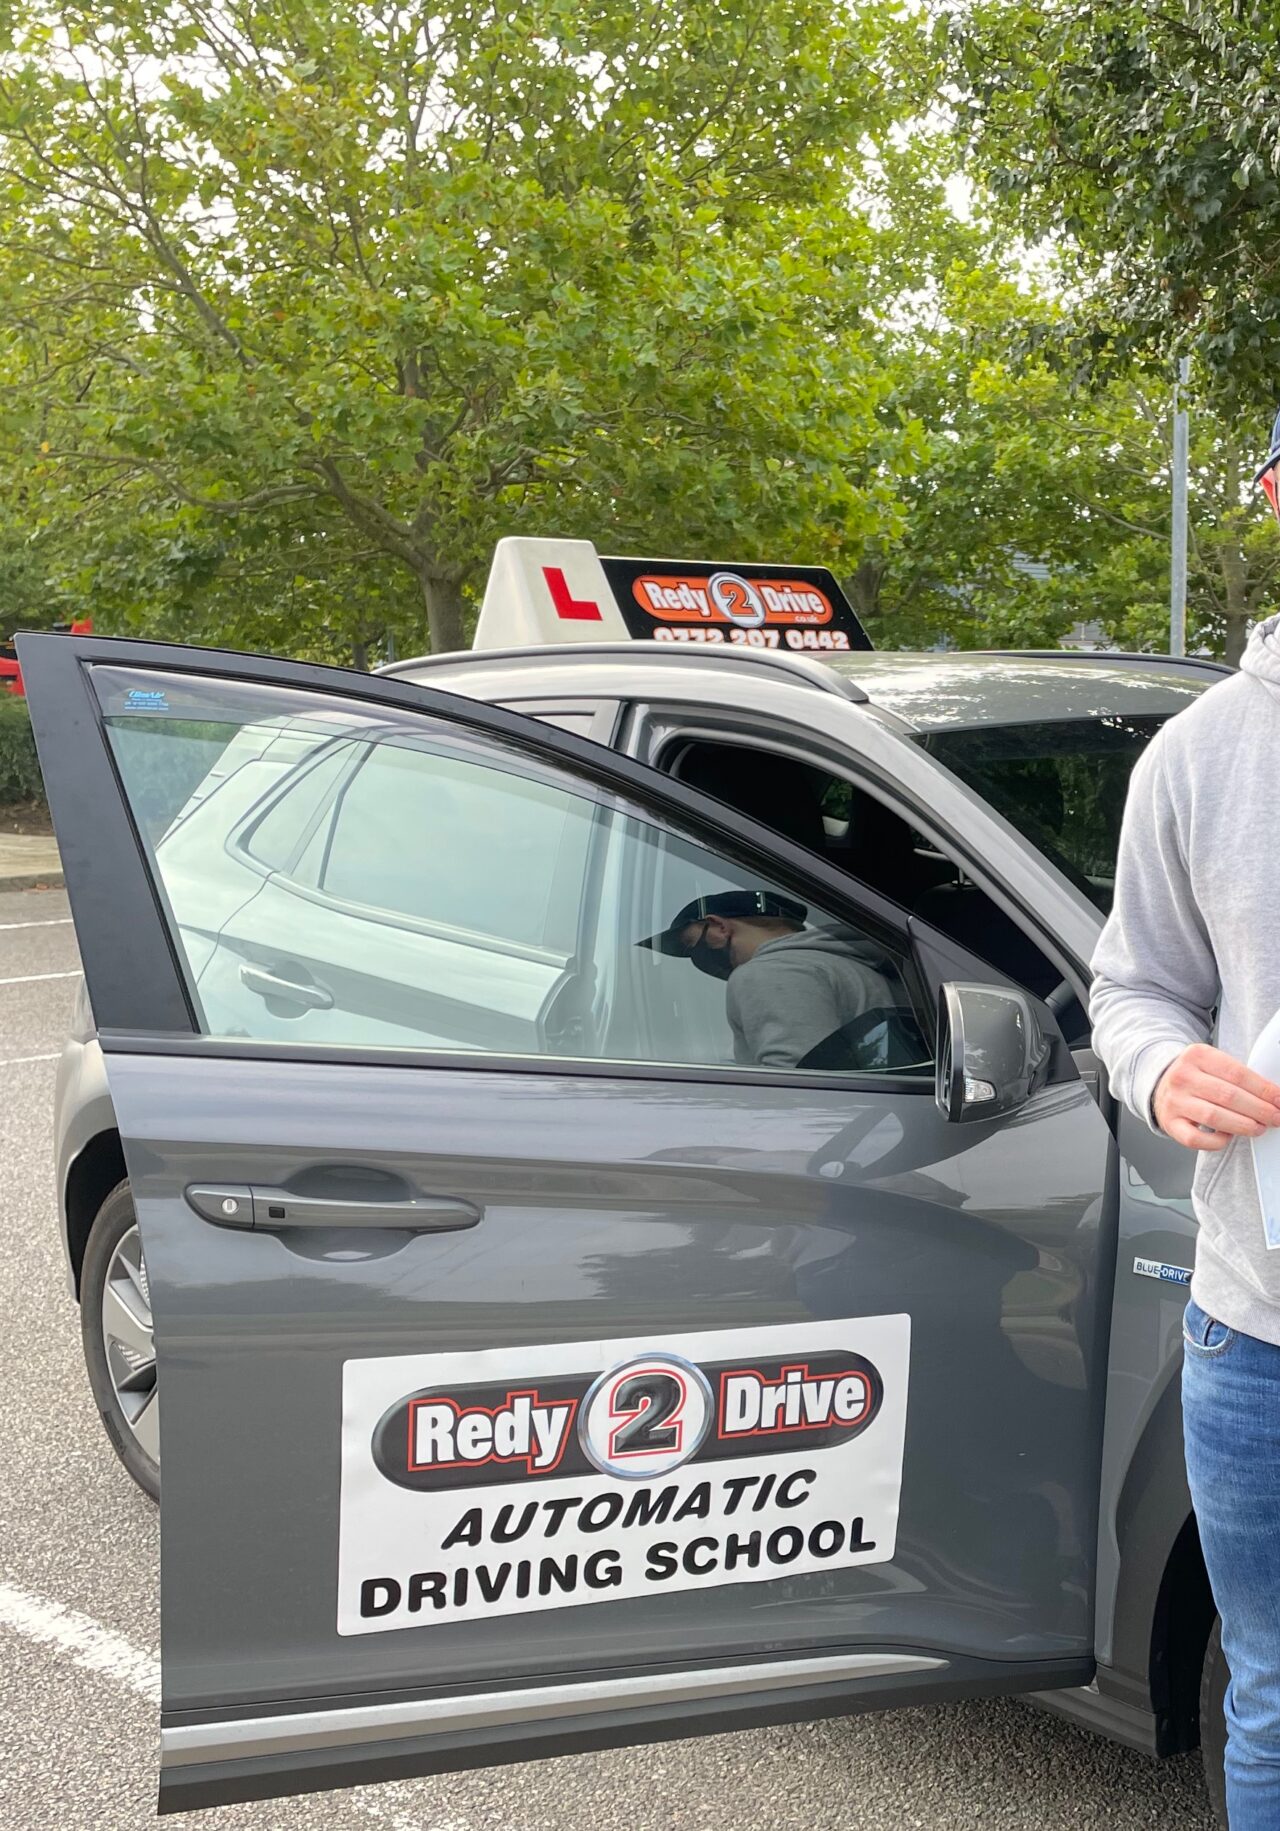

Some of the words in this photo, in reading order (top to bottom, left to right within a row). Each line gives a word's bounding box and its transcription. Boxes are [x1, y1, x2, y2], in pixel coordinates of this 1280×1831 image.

[542, 566, 603, 621] L
[641, 581, 711, 616] Redy
[718, 579, 759, 617] 2
[760, 584, 827, 614] Drive
[785, 630, 850, 650] 0442
[411, 1393, 575, 1471] Redy
[608, 1368, 687, 1459] 2
[721, 1368, 869, 1435] Drive
[440, 1468, 818, 1550] AUTOMATIC
[360, 1549, 624, 1618] DRIVING
[644, 1515, 877, 1581] SCHOOL
